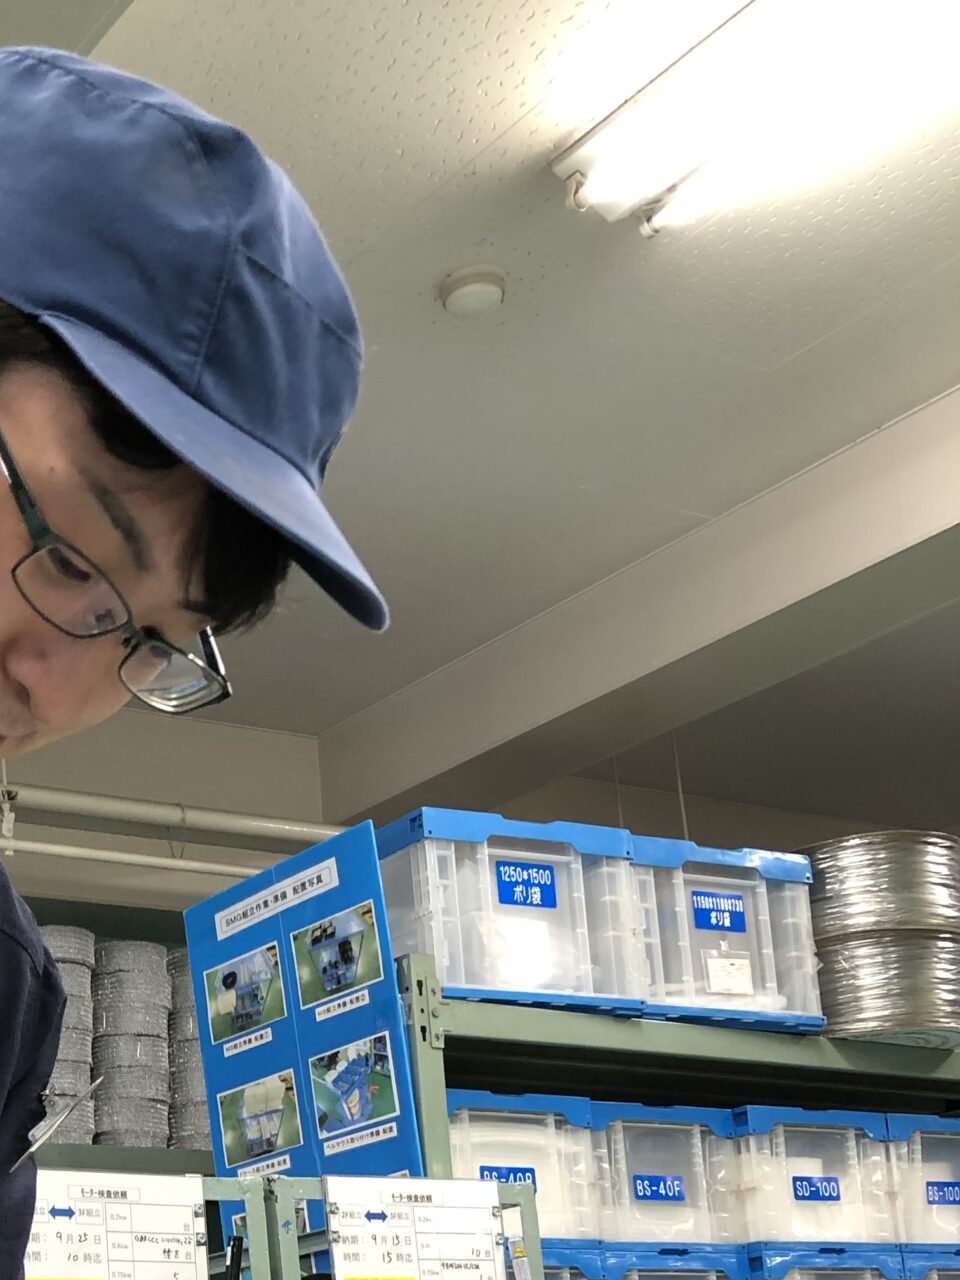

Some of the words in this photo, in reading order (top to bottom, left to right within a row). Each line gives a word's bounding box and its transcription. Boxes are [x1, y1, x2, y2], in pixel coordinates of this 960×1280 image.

[293, 875, 324, 895] 配置写真
[513, 885, 542, 905] ポリ袋
[710, 911, 731, 927] ポリ袋
[636, 1180, 681, 1197] BS-40F
[796, 1180, 838, 1197] SD-100
[183, 1222, 190, 1232] 台
[55, 1231, 62, 1242] 9
[67, 1234, 74, 1244] 月
[94, 1234, 101, 1245] 日
[371, 1234, 377, 1246] 9
[381, 1235, 387, 1245] 月
[392, 1234, 401, 1246] 15
[404, 1236, 412, 1246] 日
[67, 1252, 79, 1262] 10
[185, 1250, 192, 1260] 台
[382, 1251, 393, 1264] 15
[471, 1248, 481, 1258] 10
[484, 1250, 491, 1258] 台
